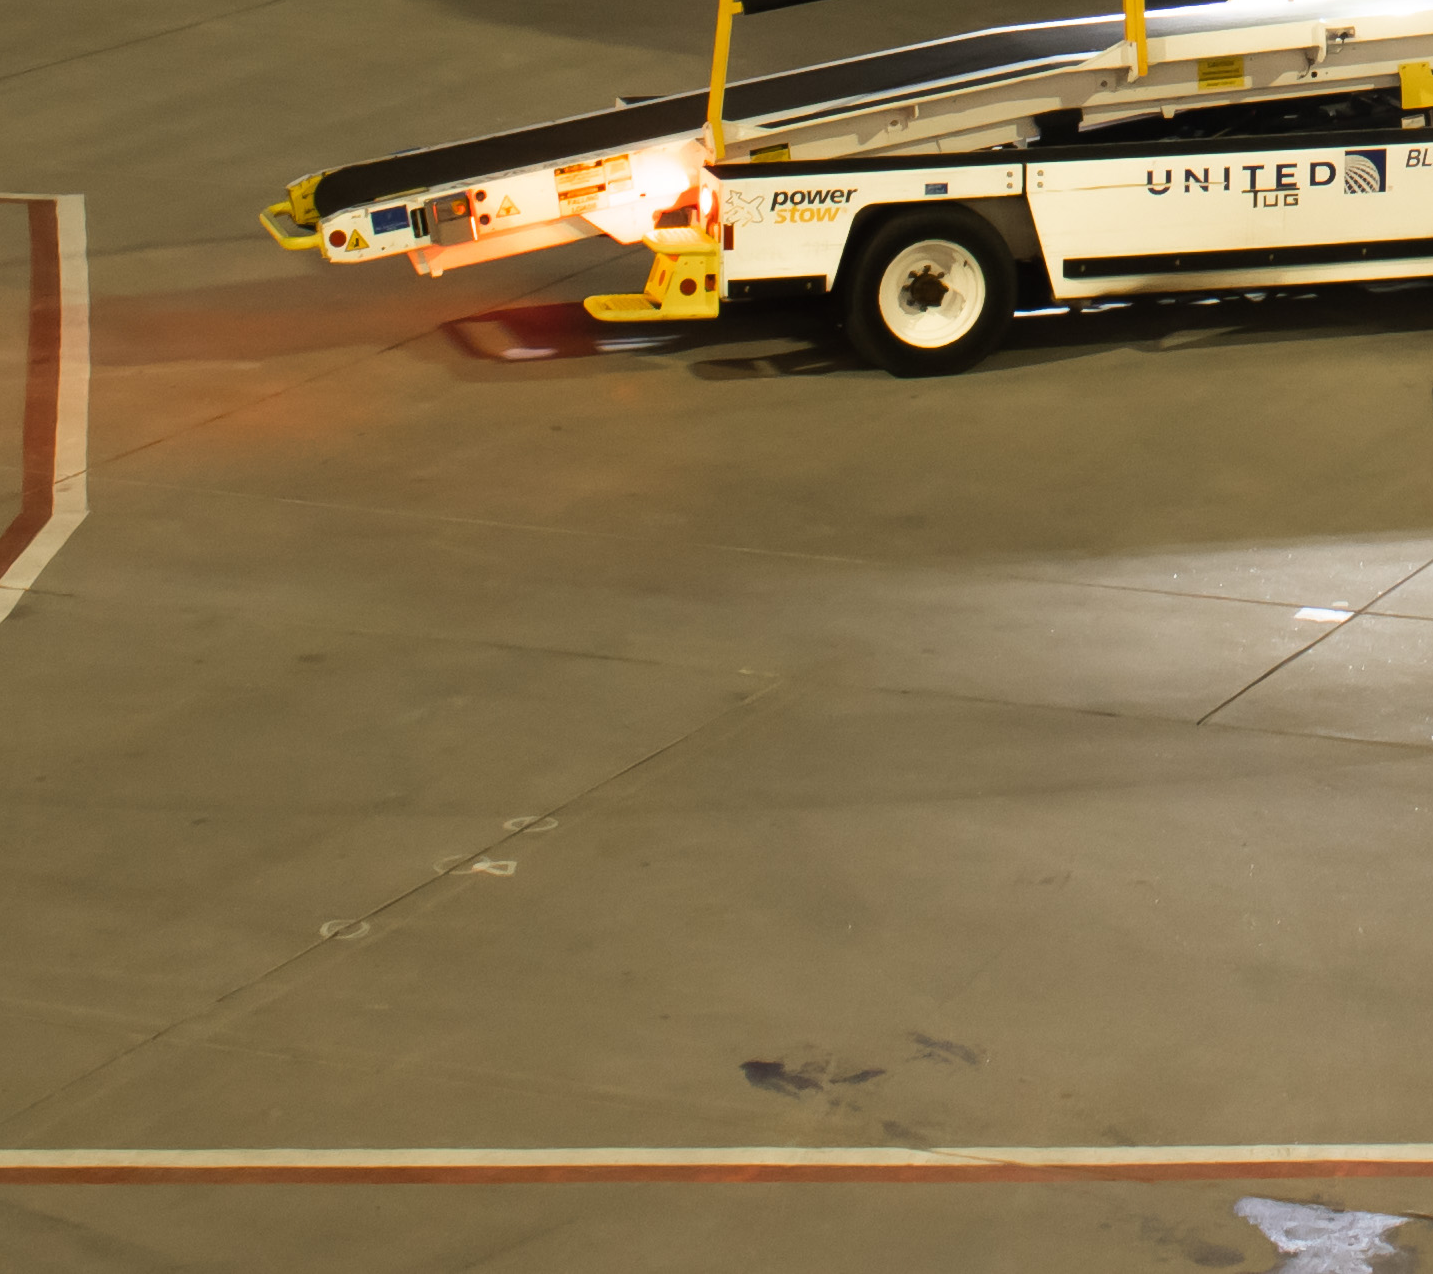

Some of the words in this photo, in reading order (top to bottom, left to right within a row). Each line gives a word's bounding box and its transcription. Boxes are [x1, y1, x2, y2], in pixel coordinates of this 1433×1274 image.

[1146, 161, 1337, 196] UNITED
[770, 188, 858, 212] power
[1241, 186, 1300, 209] TUG
[774, 205, 841, 225] stow
